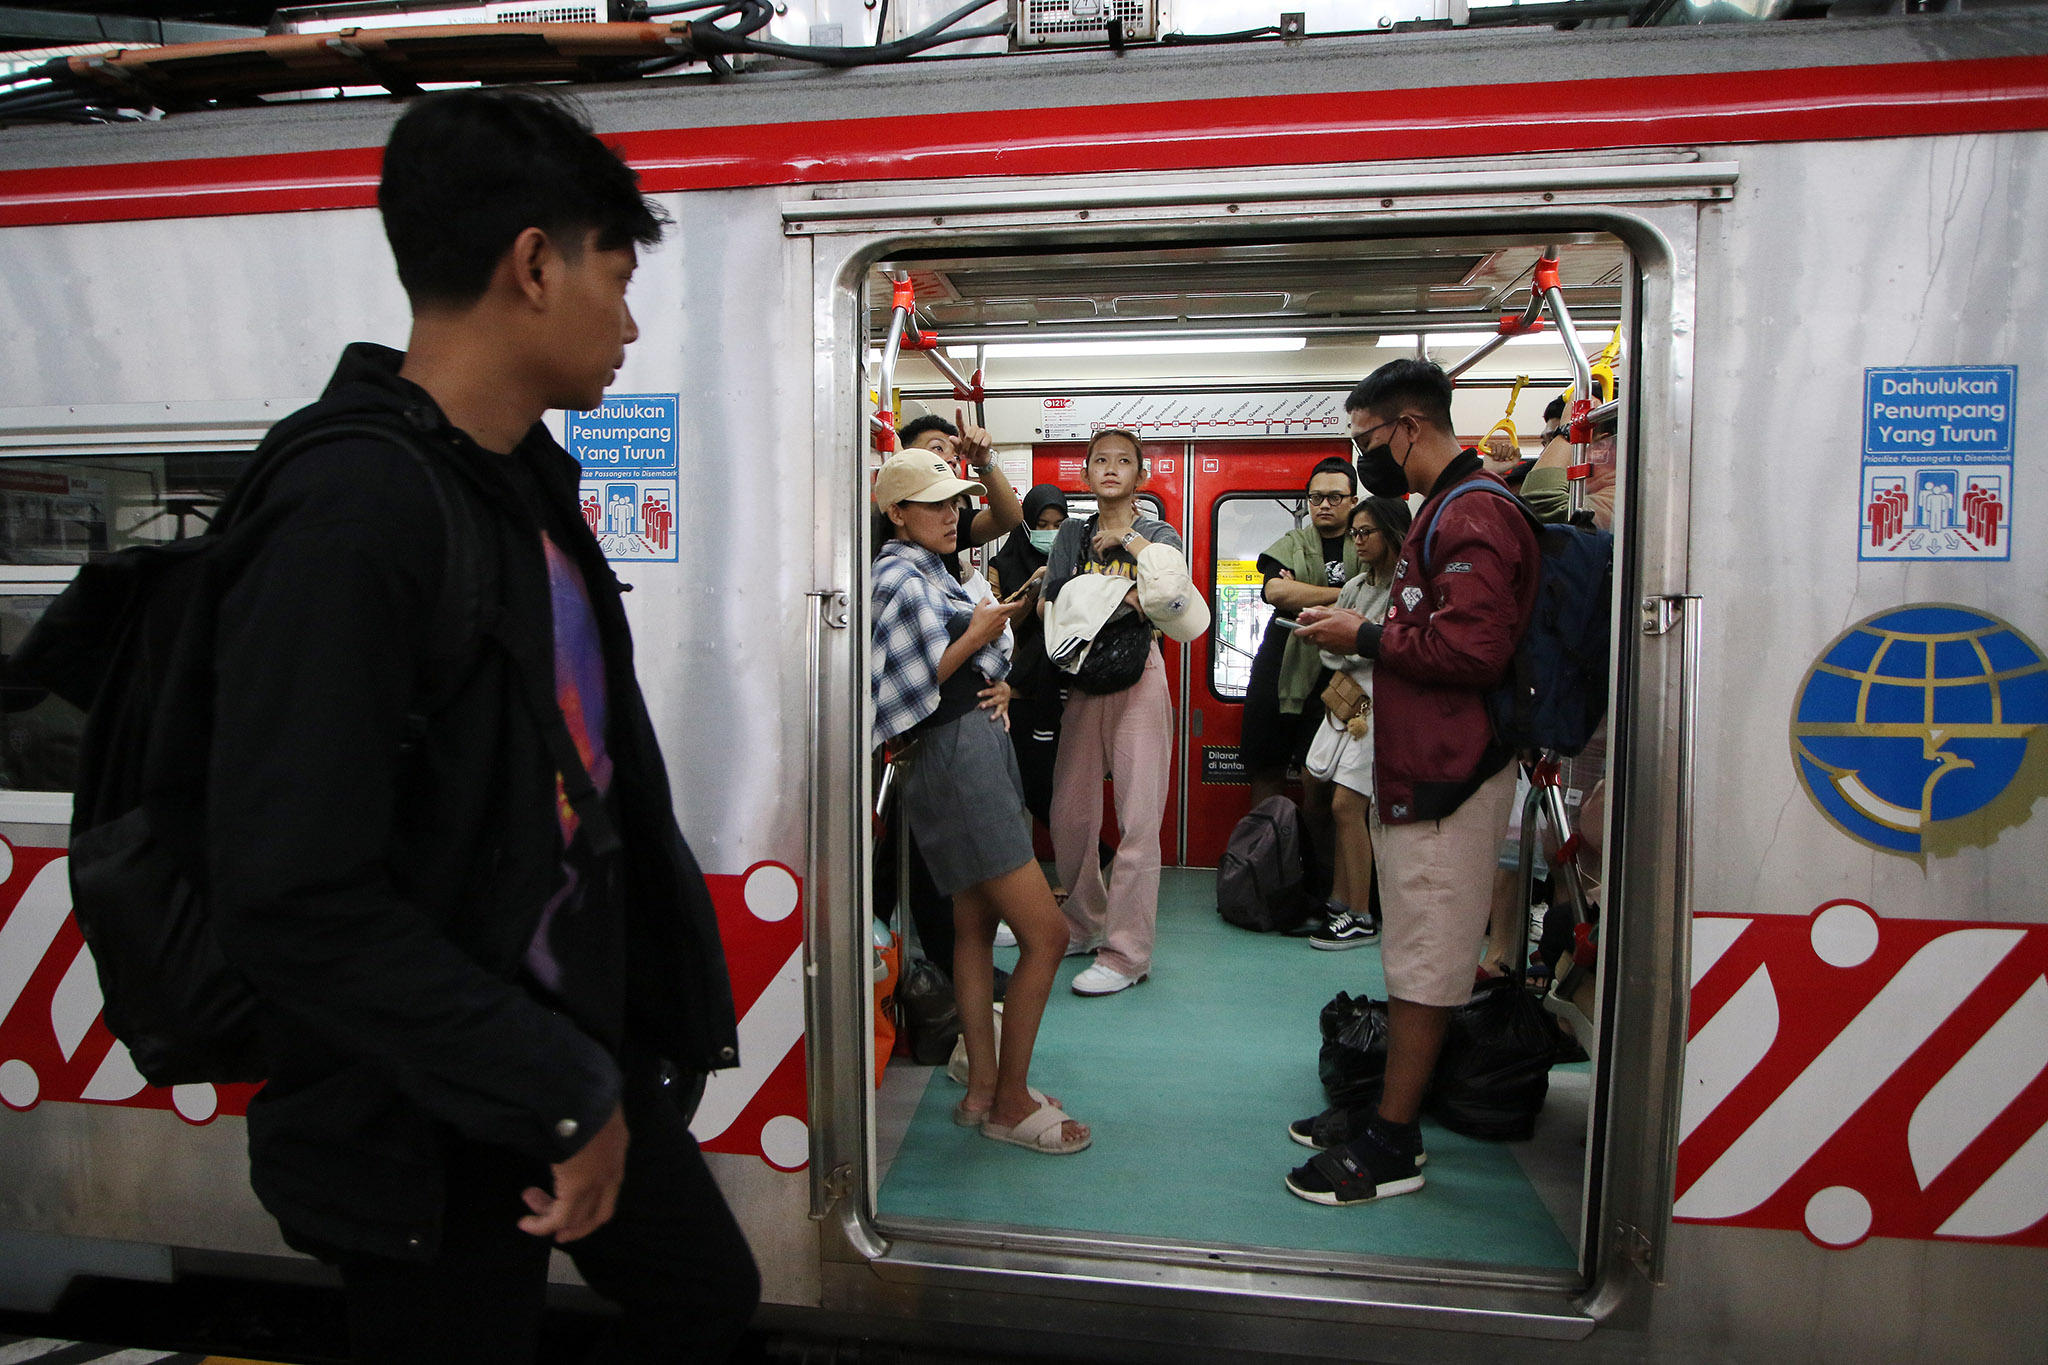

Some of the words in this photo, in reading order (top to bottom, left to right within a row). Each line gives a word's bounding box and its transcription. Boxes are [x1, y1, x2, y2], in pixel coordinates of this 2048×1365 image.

[1882, 377, 1998, 395] Dahulukan
[579, 404, 665, 419] Dahulukan
[1052, 399, 1063, 407] 121
[1100, 401, 1121, 421] Yogyakarta
[1229, 401, 1250, 418] Delanggu
[1873, 402, 2005, 422] Penumpang
[573, 425, 671, 442] Penumpang
[1878, 426, 1936, 446] Yang
[1940, 425, 1998, 442] Turun
[577, 446, 619, 463] Yang
[623, 445, 665, 460] Turun
[1953, 454, 1962, 462] to
[1964, 454, 2011, 462] Disembark
[1209, 761, 1217, 769] di
